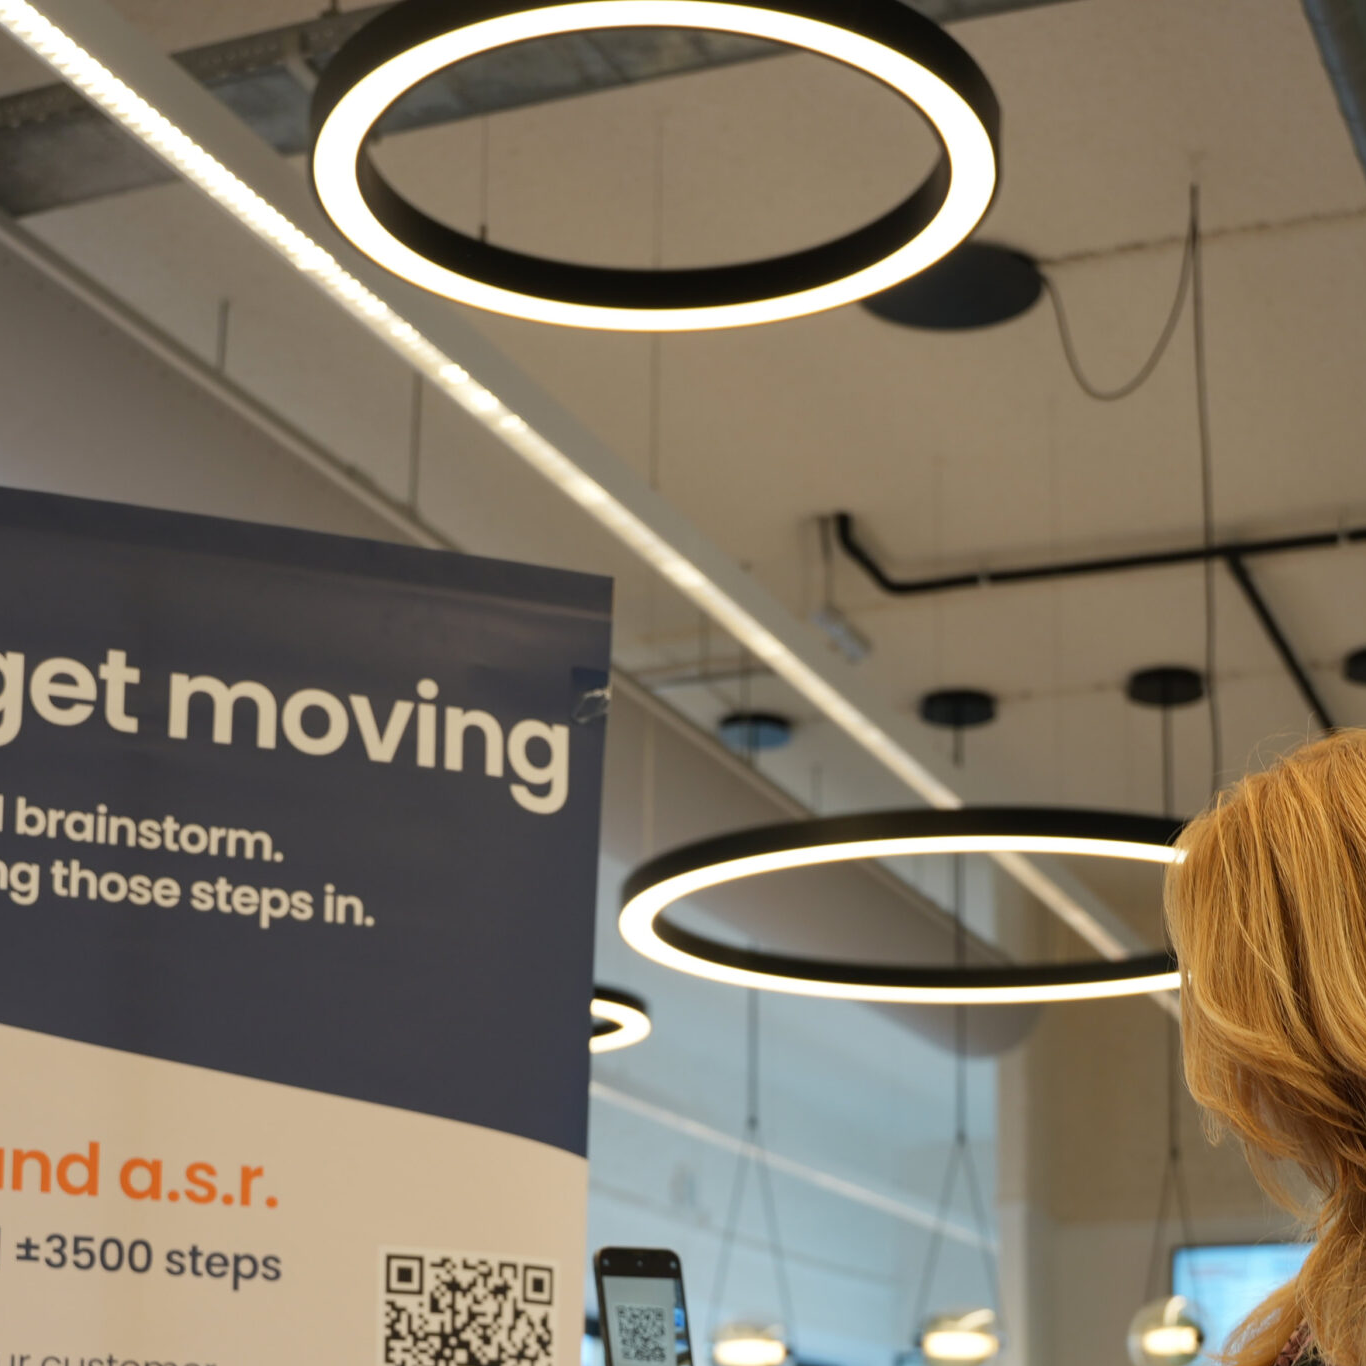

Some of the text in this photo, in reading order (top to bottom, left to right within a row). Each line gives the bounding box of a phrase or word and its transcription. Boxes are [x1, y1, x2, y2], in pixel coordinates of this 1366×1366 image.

[168, 672, 570, 815] moving
[15, 796, 284, 863] brainstorm.
[50, 859, 181, 908] those
[190, 876, 314, 929] steps
[324, 883, 375, 927] in.
[119, 1157, 278, 1209] a.s.r.
[15, 1233, 153, 1274] ±3500
[165, 1244, 282, 1292] steps
